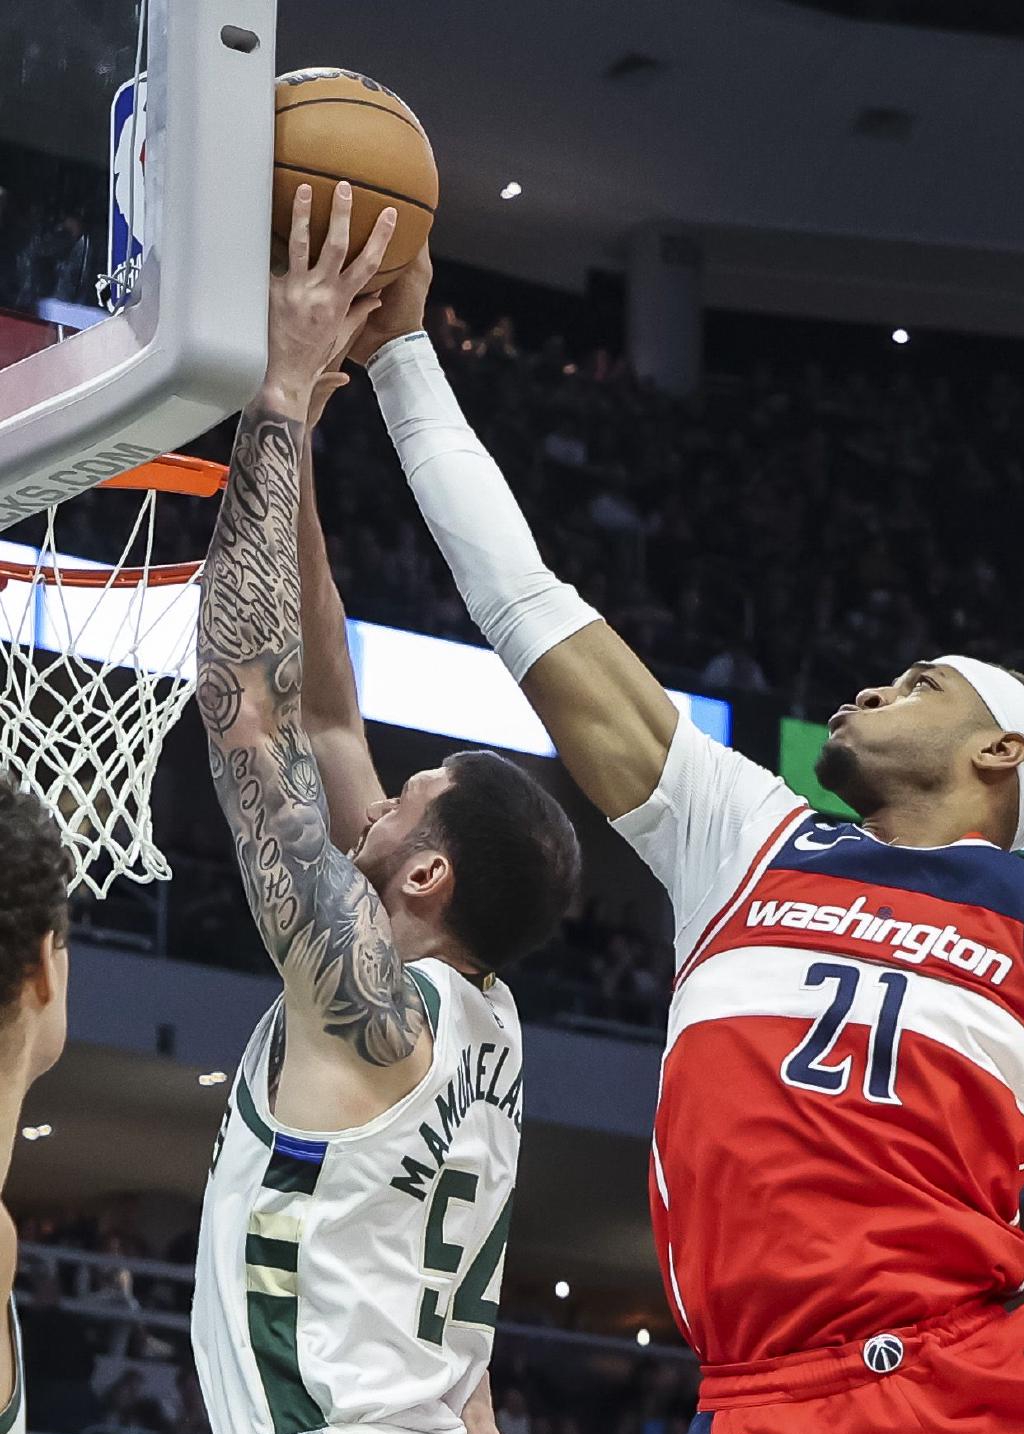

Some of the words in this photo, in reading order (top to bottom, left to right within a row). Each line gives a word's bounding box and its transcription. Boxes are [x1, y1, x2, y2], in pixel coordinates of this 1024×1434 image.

[746, 896, 1013, 985] washington
[782, 961, 908, 1105] 21
[389, 1043, 523, 1202] MAMUKELA
[416, 1167, 517, 1347] 54
